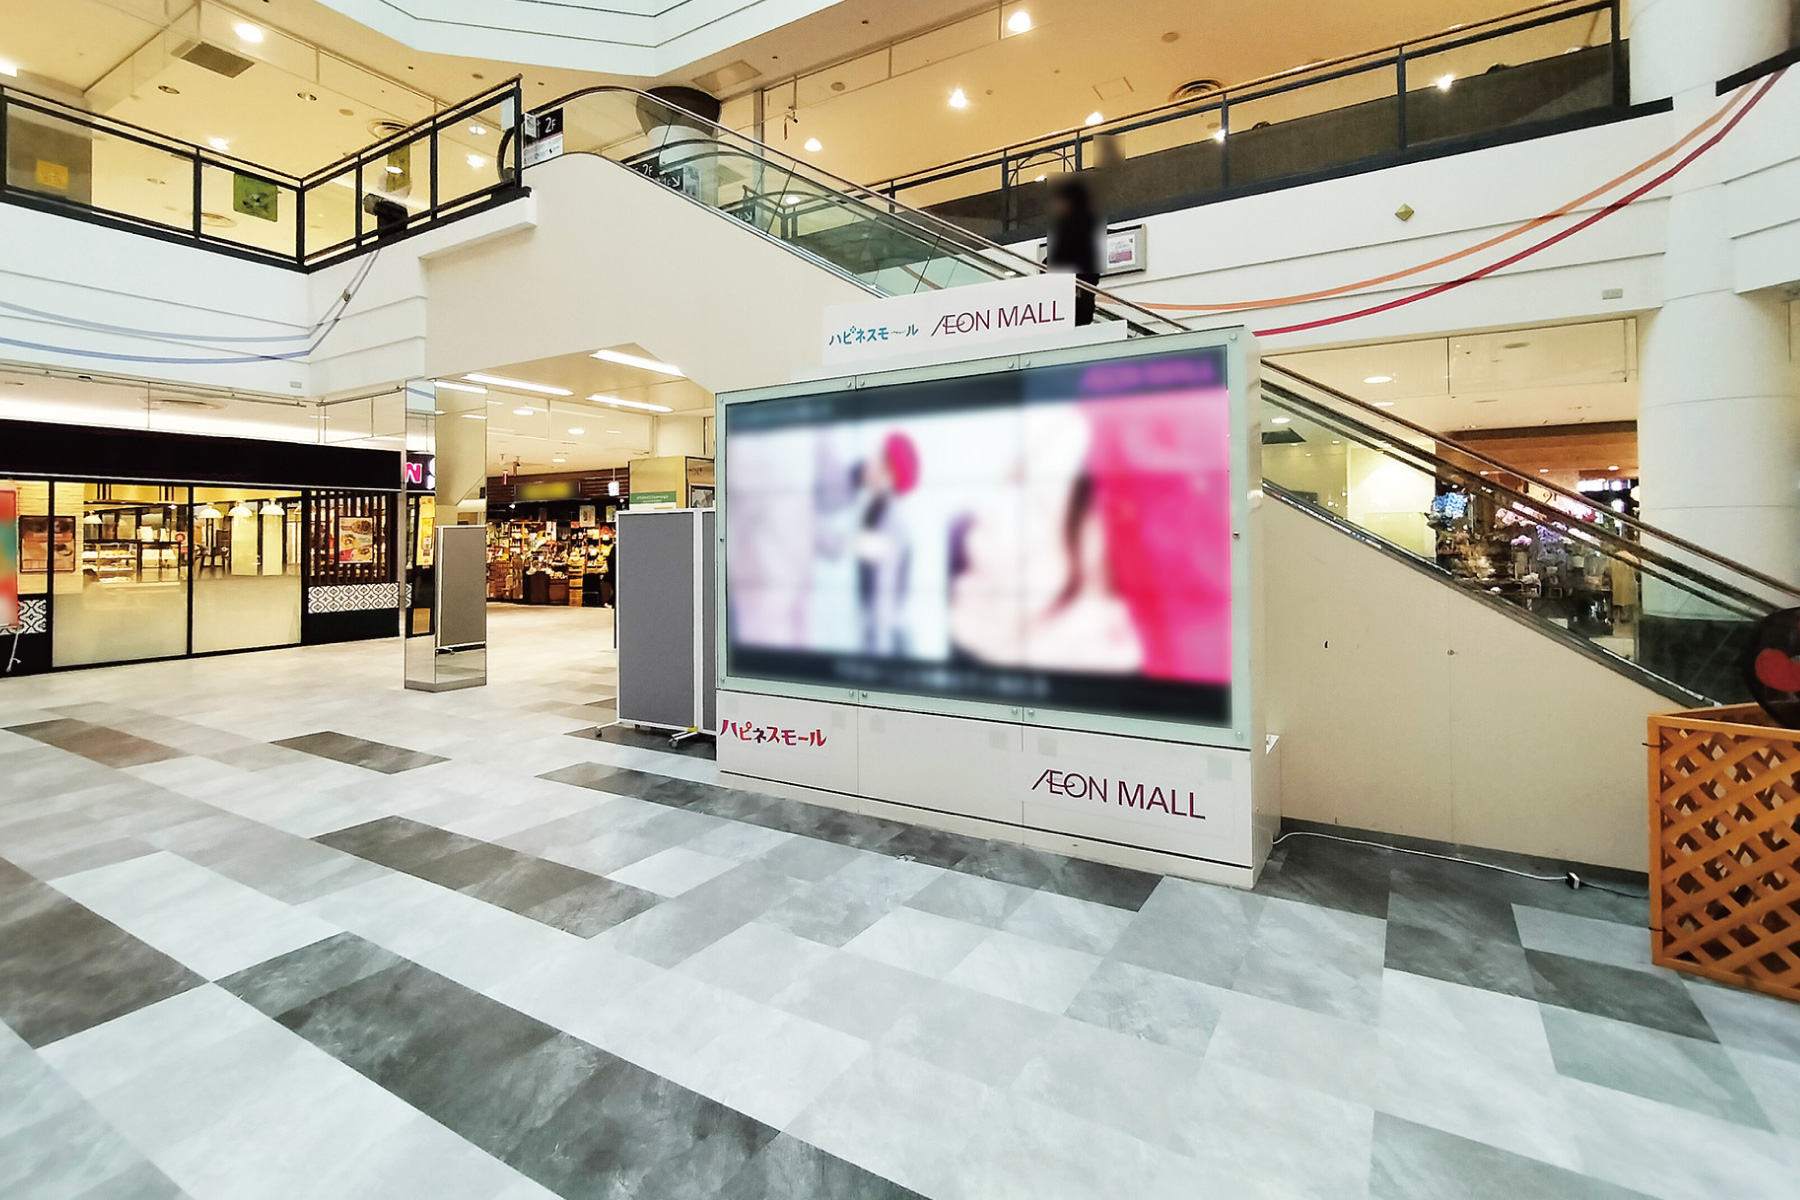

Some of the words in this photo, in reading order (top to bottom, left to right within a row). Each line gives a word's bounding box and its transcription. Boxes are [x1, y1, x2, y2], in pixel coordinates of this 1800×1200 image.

[544, 116, 556, 133] 2F
[998, 300, 1065, 328] MALL
[720, 719, 828, 747] ハピネスモール
[1118, 780, 1206, 820] MALL
